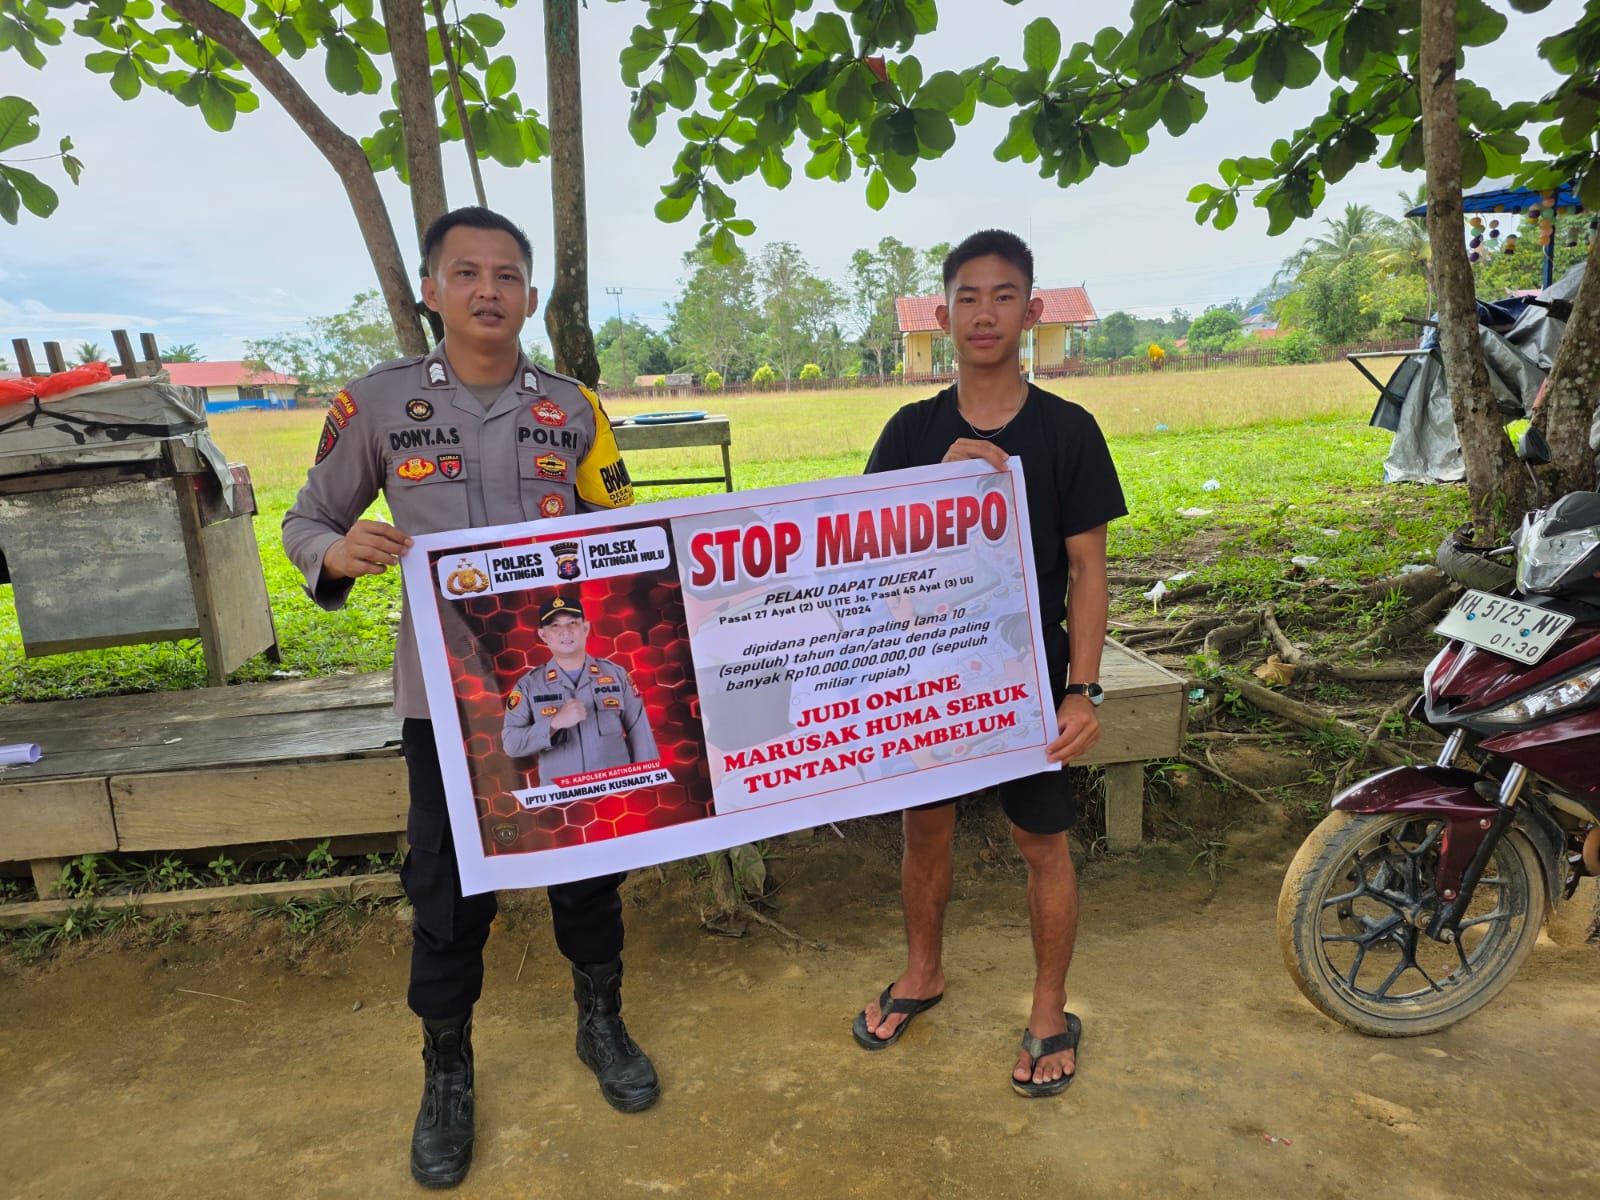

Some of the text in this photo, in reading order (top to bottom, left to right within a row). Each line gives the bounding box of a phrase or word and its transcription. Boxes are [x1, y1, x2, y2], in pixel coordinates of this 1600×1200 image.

[389, 427, 460, 451] DONY.A.S
[518, 426, 578, 449] POLRI
[589, 539, 637, 558] POLSEK
[690, 490, 1008, 587] STOP MANDEPO
[492, 552, 543, 572] POLRES
[494, 567, 545, 584] KATINGAN
[590, 549, 665, 570] KATINGAN HULU
[719, 575, 974, 625] Pasal 27 Ayat (2) UU ITE Jo. Pasal 45 Ayat (3) UU
[764, 568, 937, 606] PELAKU DAPAT DIJERAT
[836, 605, 872, 620] 1/2024
[1456, 593, 1568, 637] KH 5125 NV
[719, 620, 991, 679] (sepuluh) tahun dan/atau denda paling
[742, 607, 966, 658] dipidana penjara paling lama 10
[726, 634, 988, 692] banyak Rp10.000.000.000,00 (sepuluh
[814, 663, 912, 692] miliar rupiah)
[796, 673, 961, 728] JUDI ONLINE
[722, 682, 1029, 773] MARUSAK HUMA SERUK
[743, 711, 1017, 795] TUNTANG PAMBELUM
[525, 771, 668, 805] IPTU YUBAMBANG KUSNADY, SH
[572, 772, 607, 784] KAPOLSEK
[608, 765, 641, 778] KATINGAN
[642, 761, 660, 771] HULU
